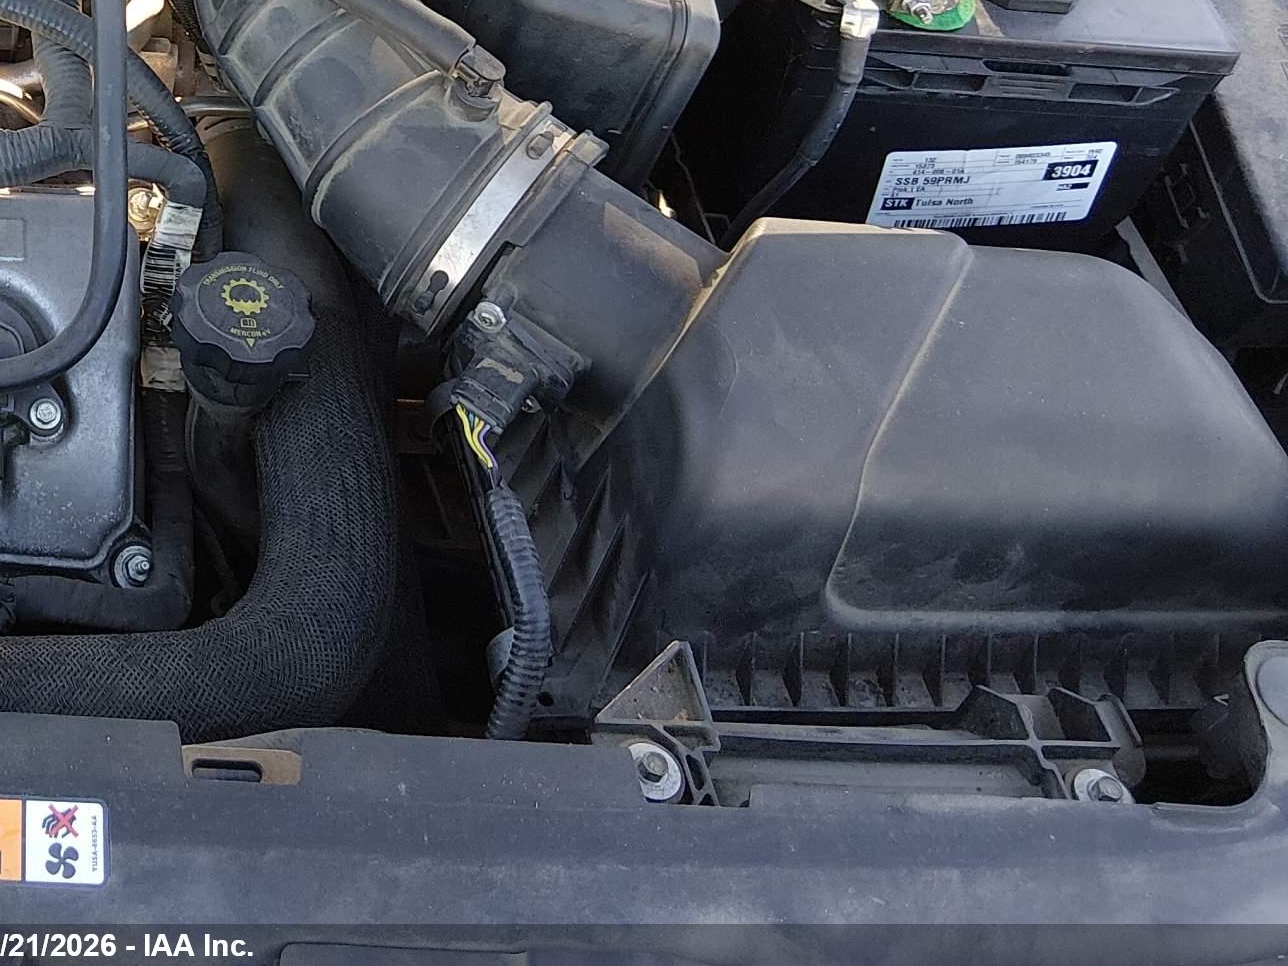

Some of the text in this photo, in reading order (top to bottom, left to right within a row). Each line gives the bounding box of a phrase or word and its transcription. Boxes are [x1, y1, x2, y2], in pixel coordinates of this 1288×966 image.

[1050, 163, 1091, 179] 3904
[894, 176, 971, 186] SSB 59PRMJ
[884, 198, 910, 208] STK
[916, 197, 974, 207] Tulsa North
